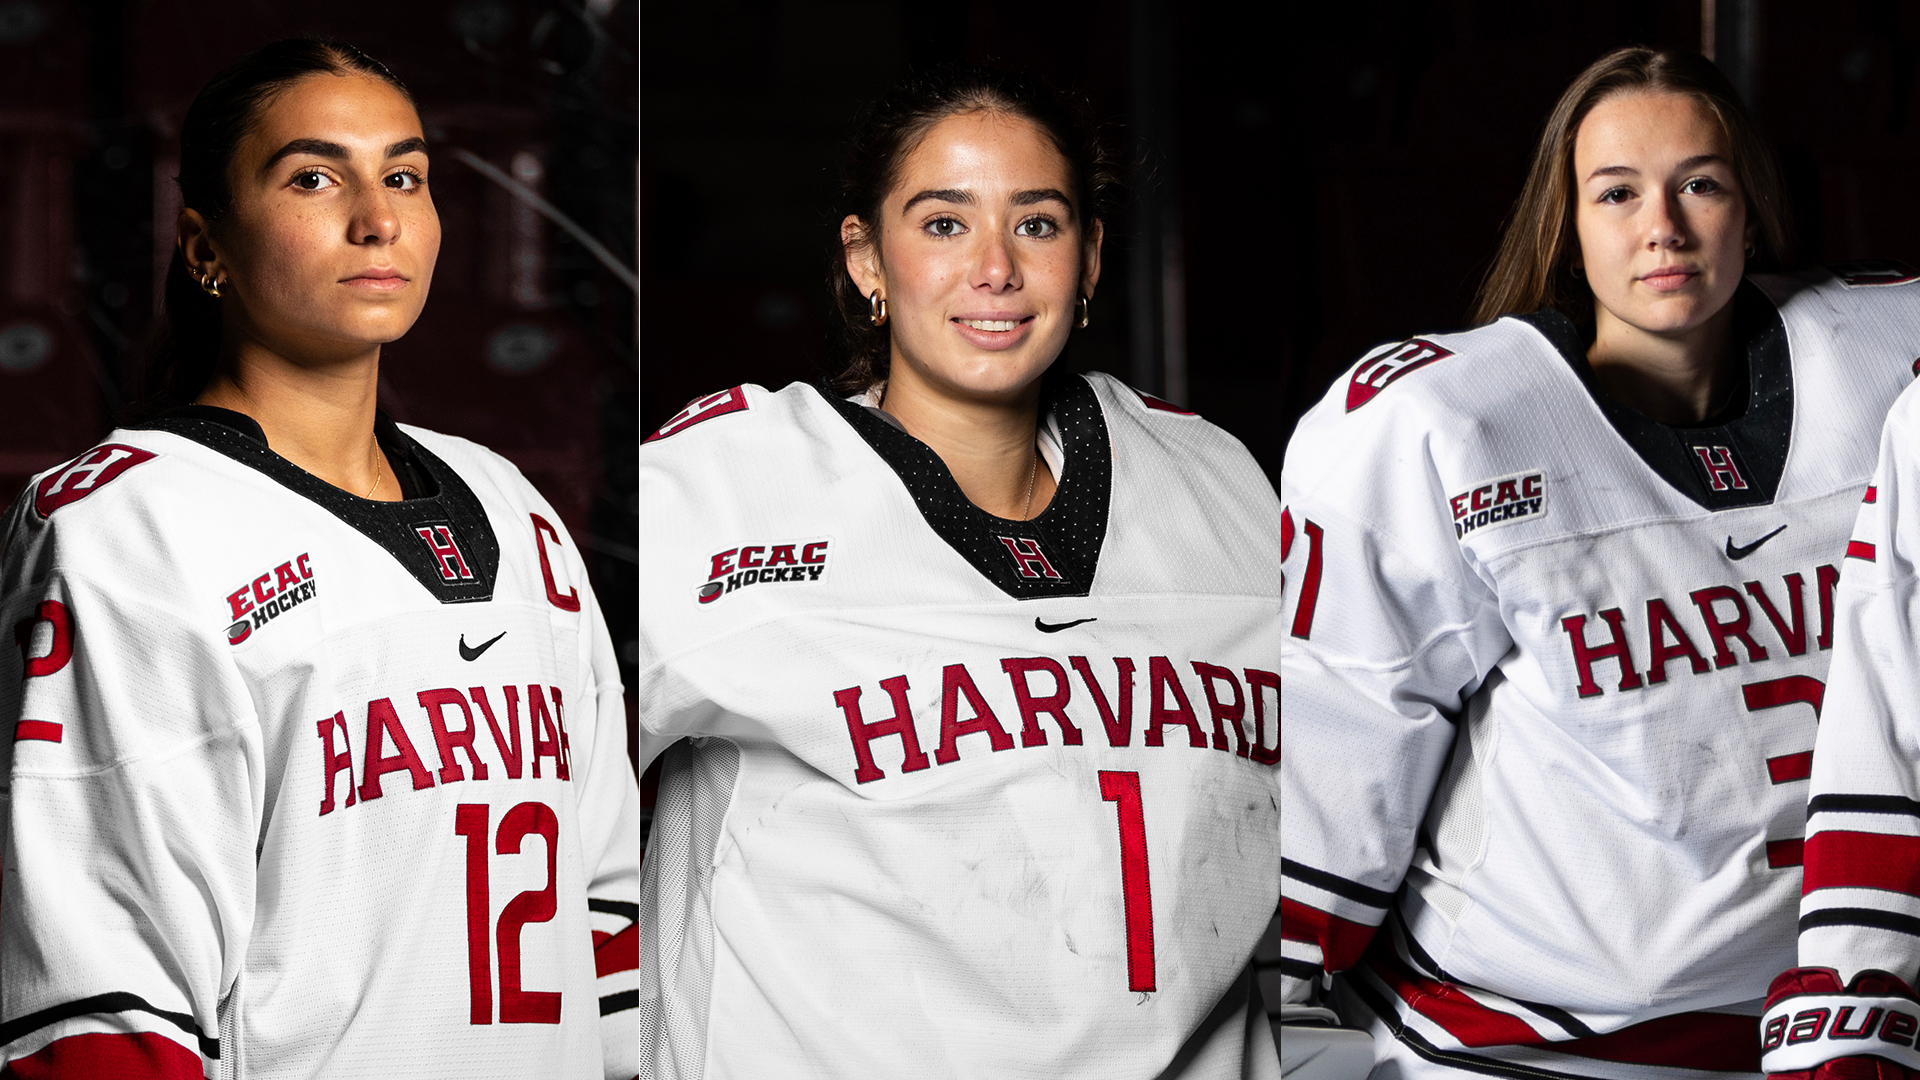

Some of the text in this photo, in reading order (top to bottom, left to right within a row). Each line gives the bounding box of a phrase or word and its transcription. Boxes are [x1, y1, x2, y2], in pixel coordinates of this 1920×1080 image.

[1355, 344, 1436, 389] H
[44, 448, 133, 498] H
[1693, 446, 1748, 491] H
[1450, 474, 1542, 522] ECAC
[1463, 497, 1542, 535] HOCKEY
[415, 525, 474, 580] H
[529, 512, 581, 612] C
[708, 541, 828, 582] ECAC
[997, 536, 1062, 579] H
[1281, 505, 1324, 641] 1
[226, 551, 313, 623] ECAC
[251, 579, 316, 631] HOCKEY
[725, 565, 825, 594] HOCKEY
[1561, 563, 1841, 698] HARV
[833, 655, 1281, 784] HARVARD
[1098, 769, 1157, 993] 1
[455, 801, 563, 1026] 12
